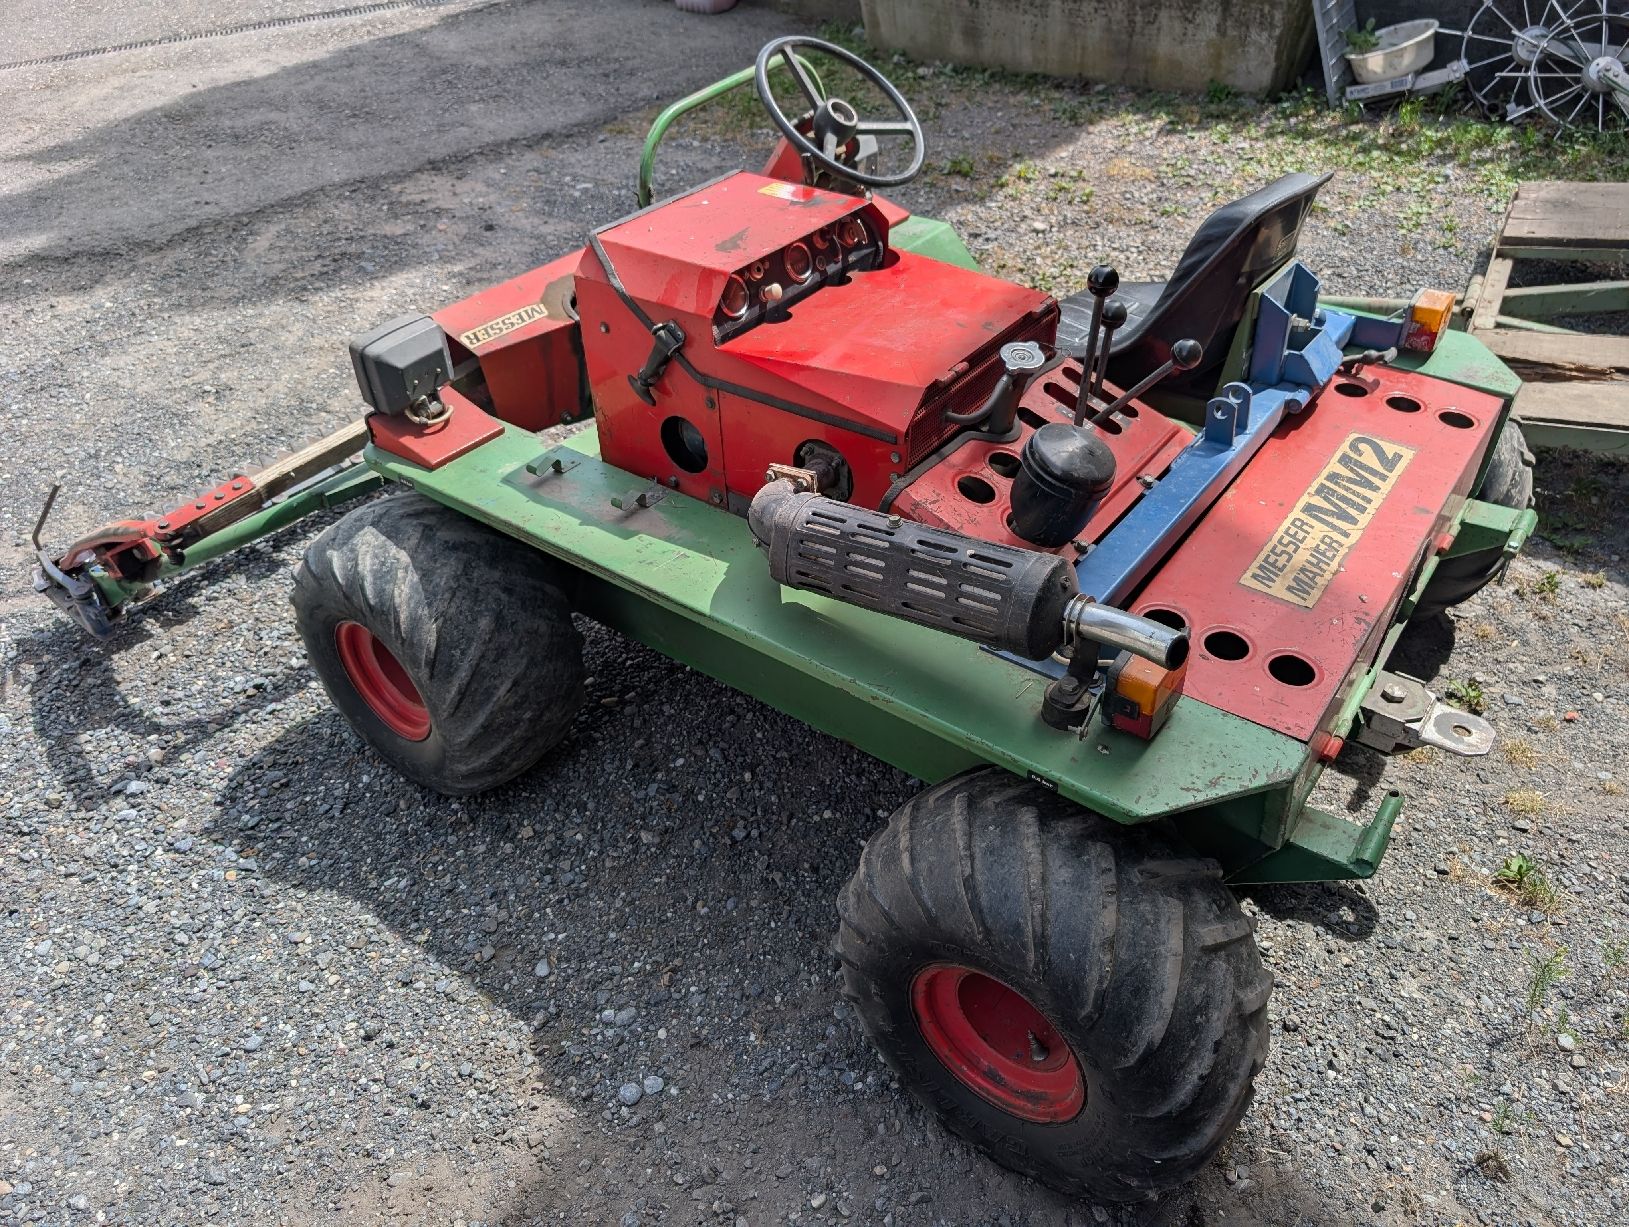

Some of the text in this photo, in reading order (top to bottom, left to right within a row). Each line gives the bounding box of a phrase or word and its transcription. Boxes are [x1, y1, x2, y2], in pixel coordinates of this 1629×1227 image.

[465, 304, 545, 346] MESSER
[1300, 436, 1404, 539] MM2
[1250, 517, 1315, 589] MESSER
